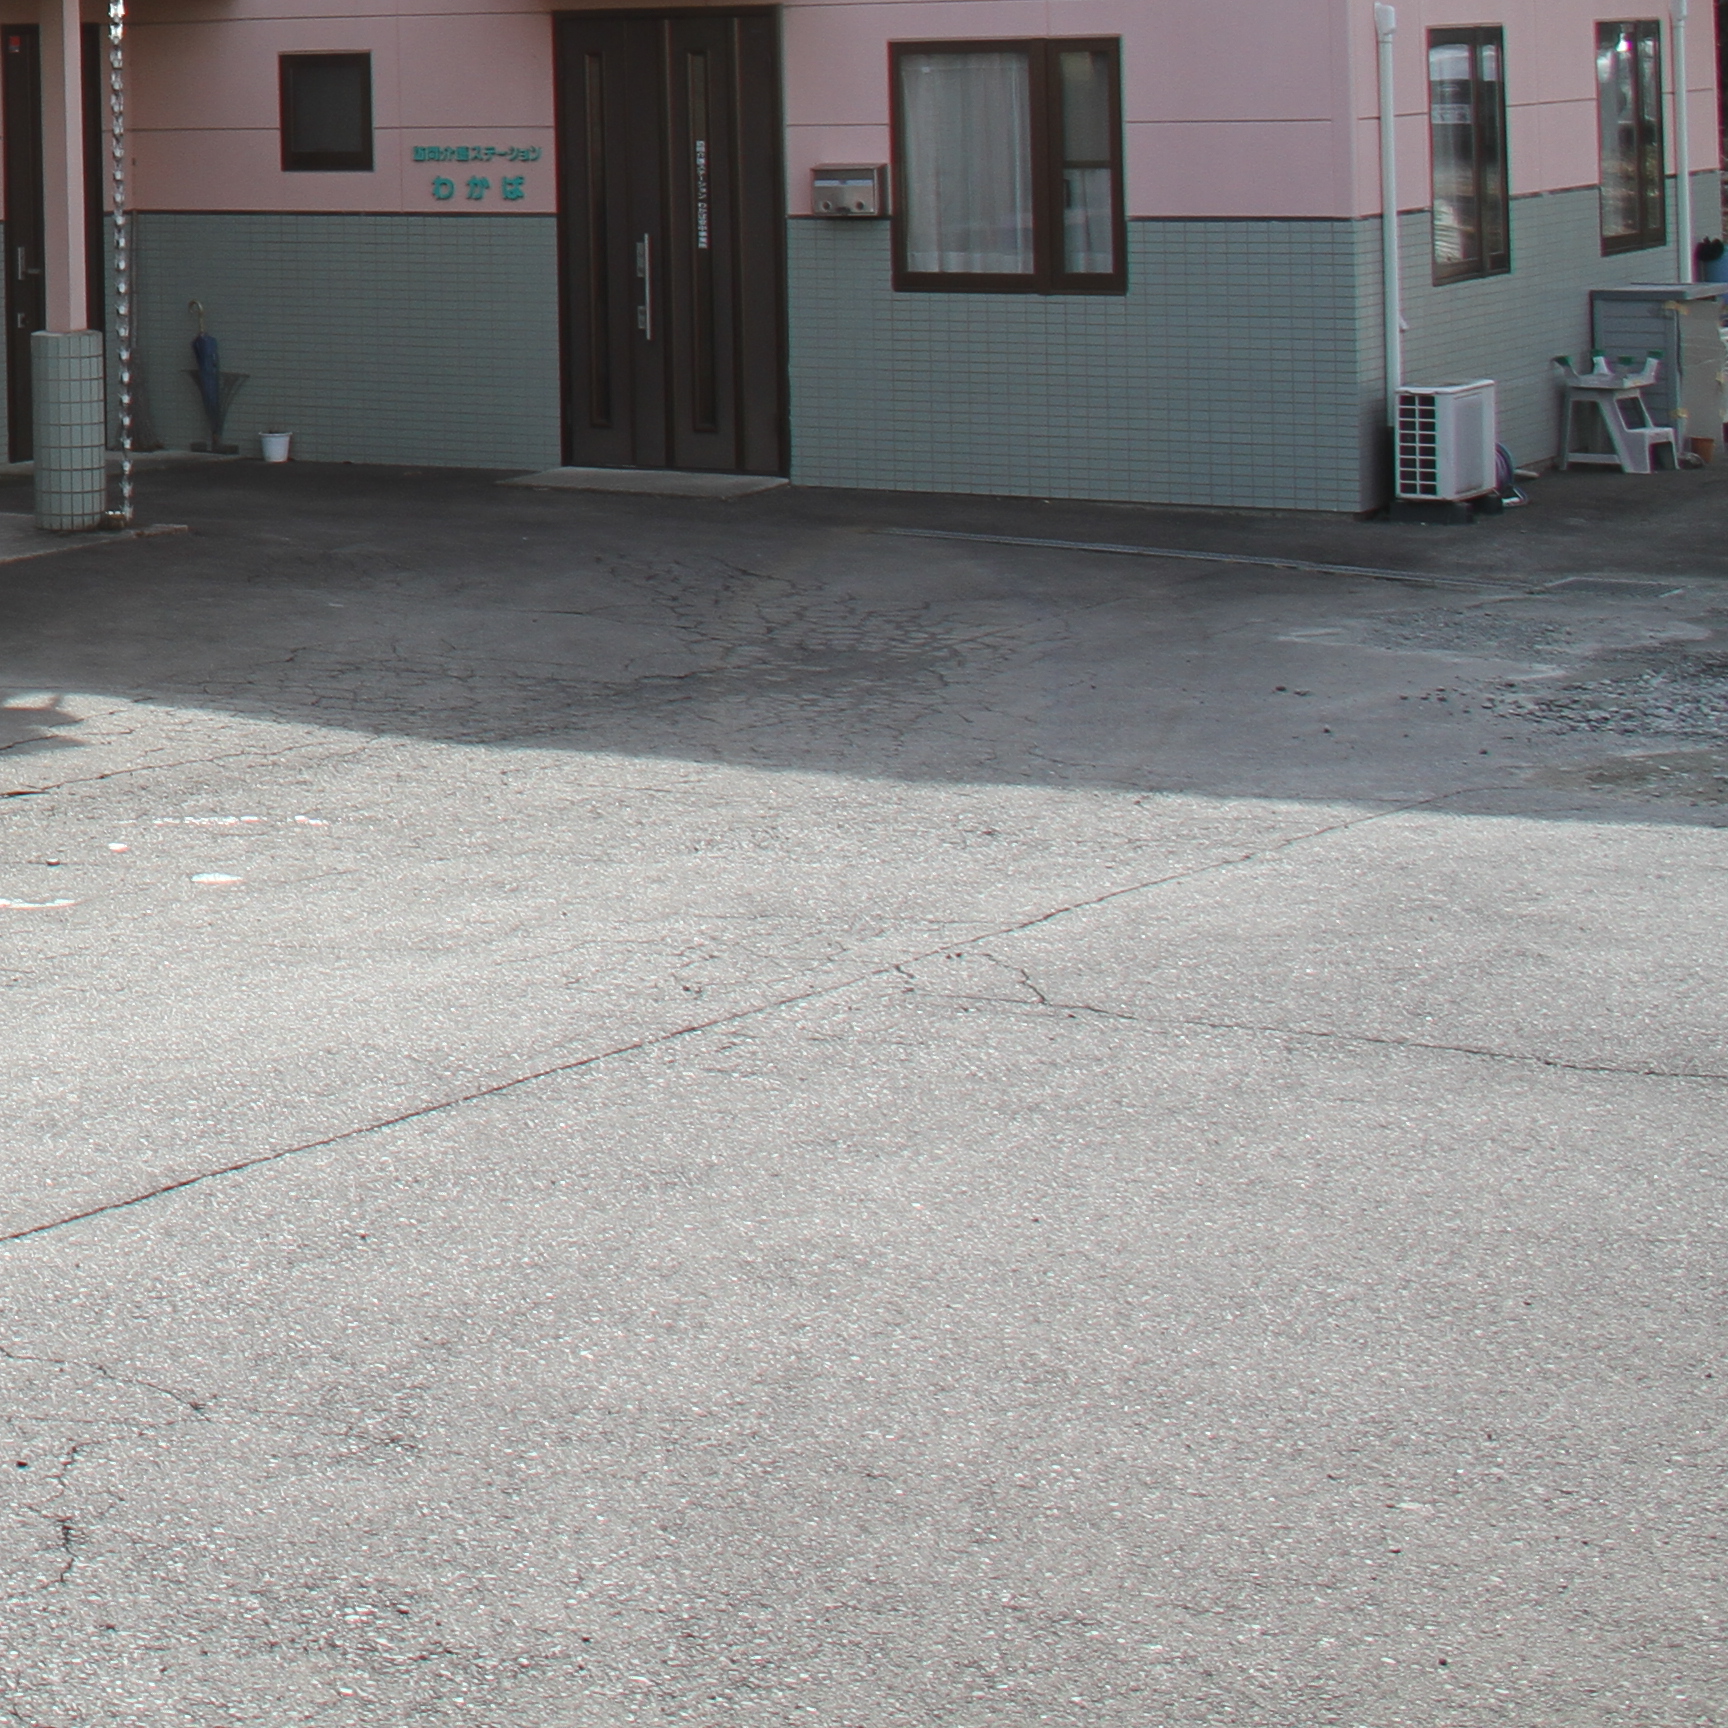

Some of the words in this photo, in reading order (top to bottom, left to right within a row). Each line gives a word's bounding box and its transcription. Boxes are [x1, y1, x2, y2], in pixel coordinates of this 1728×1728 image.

[412, 145, 542, 162] 訪問介護ステーション
[431, 175, 526, 200] わかば
